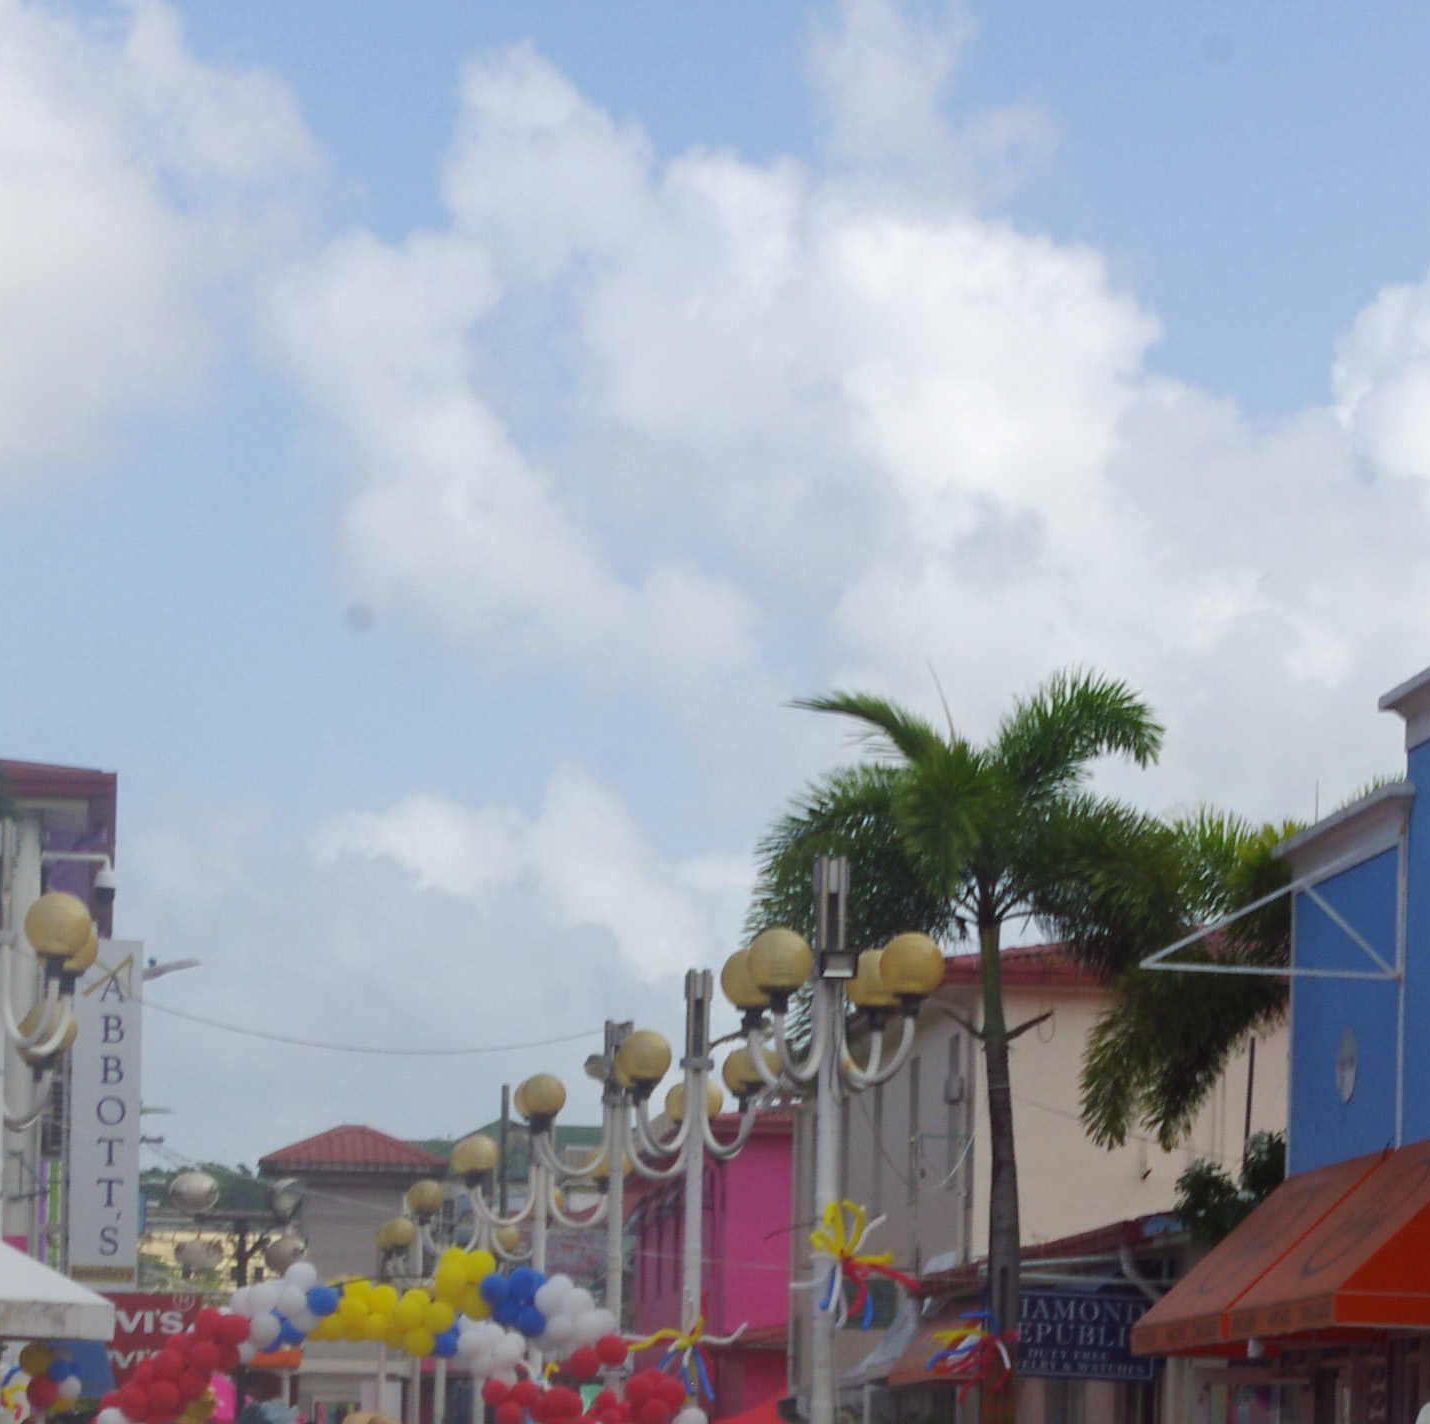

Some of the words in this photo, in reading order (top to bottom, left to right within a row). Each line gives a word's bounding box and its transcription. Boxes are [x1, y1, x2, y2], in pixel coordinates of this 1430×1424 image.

[96, 976, 127, 1256] ABBOTT'S
[1021, 1297, 1146, 1322] IAMOND
[1018, 1322, 1126, 1347] EPUBLI
